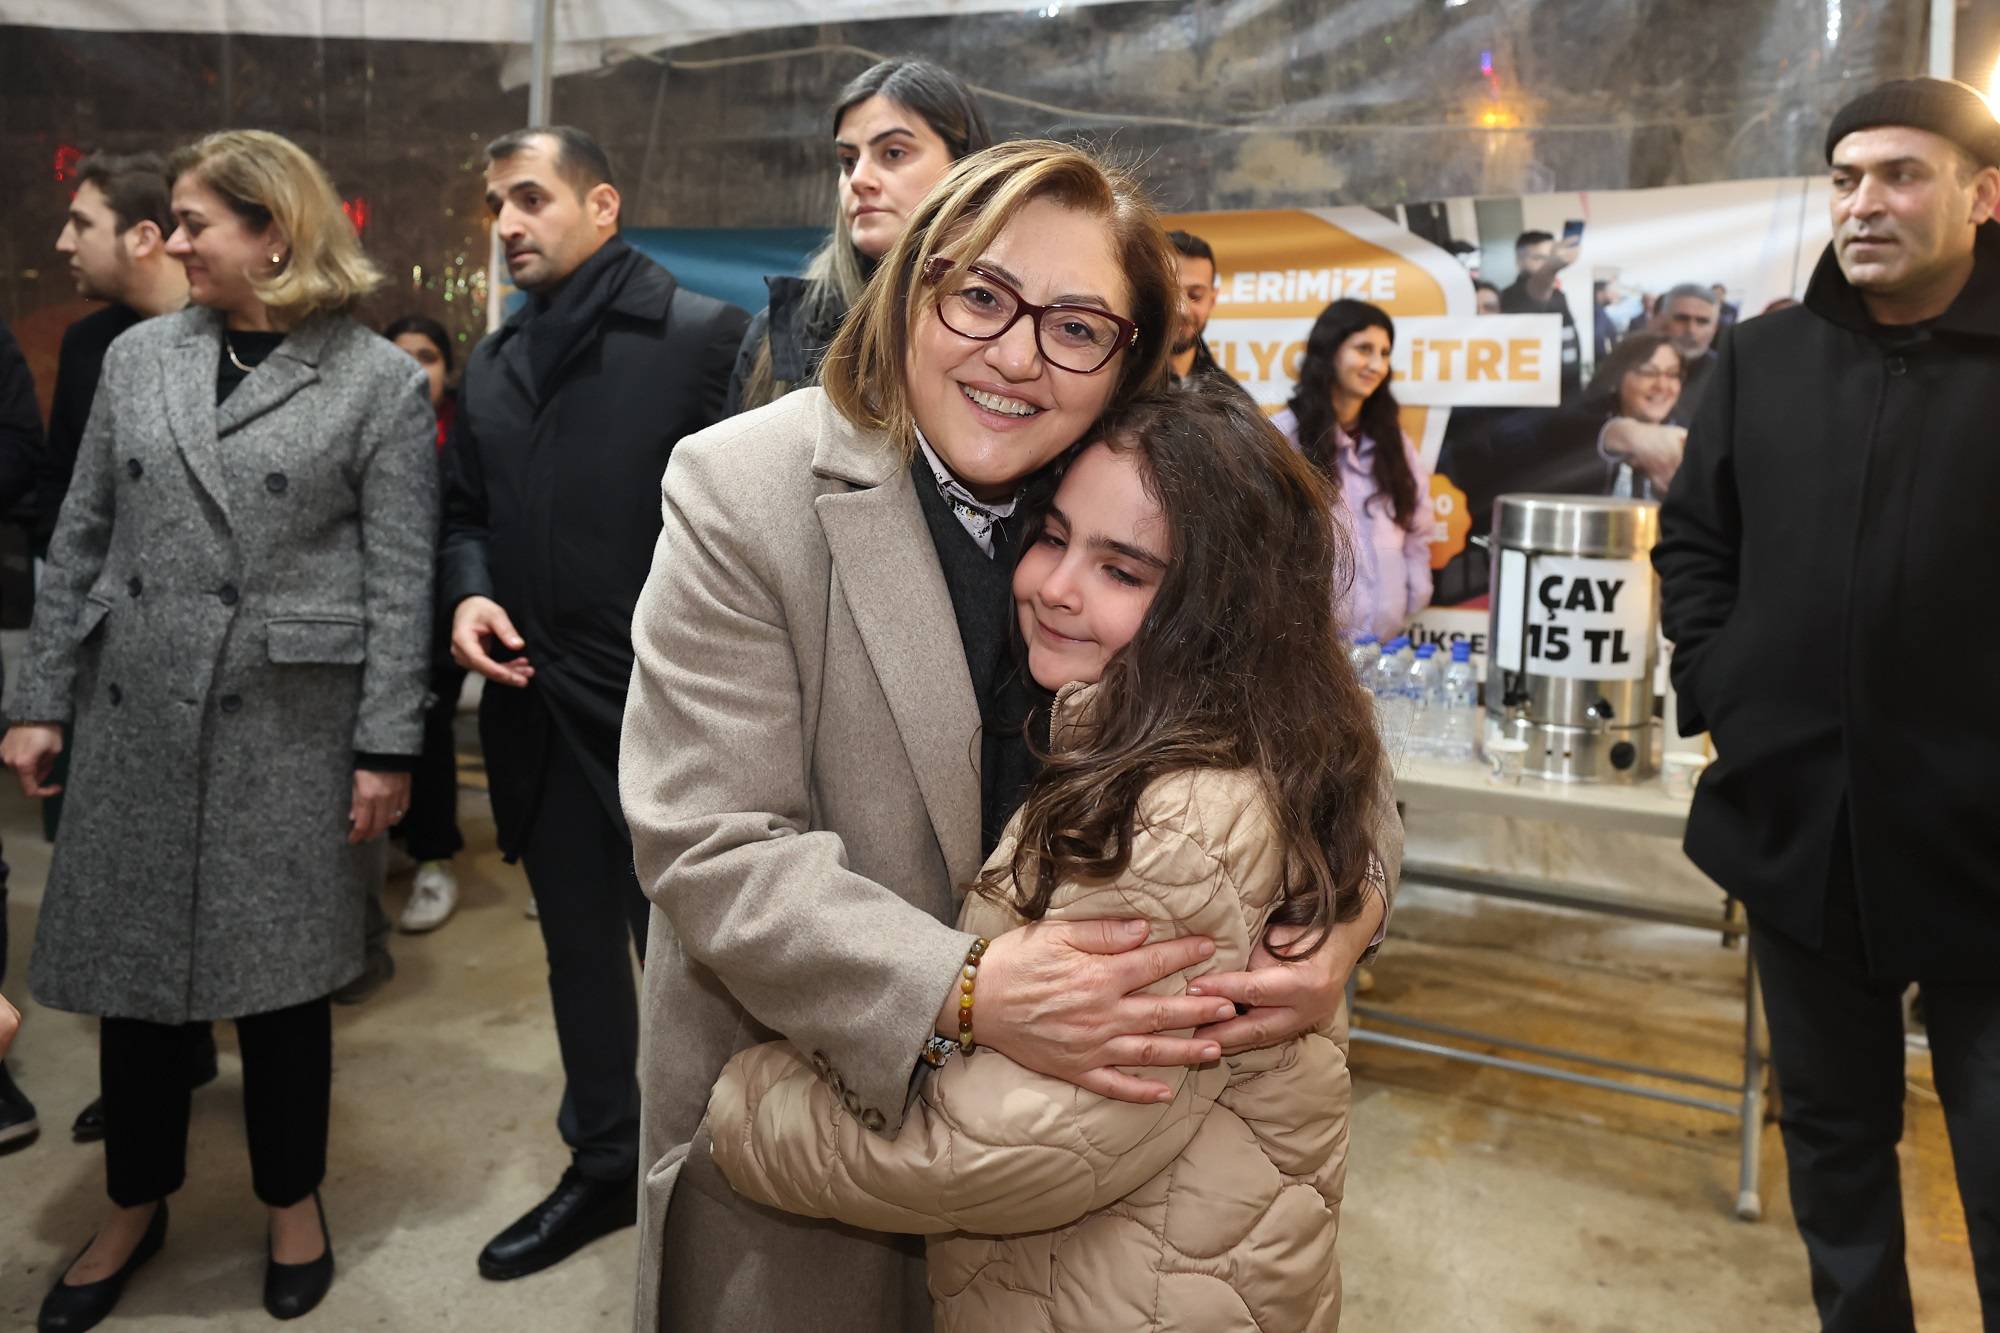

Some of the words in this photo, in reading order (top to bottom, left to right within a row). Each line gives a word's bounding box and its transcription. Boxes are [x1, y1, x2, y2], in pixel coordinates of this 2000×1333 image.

[1538, 575, 1624, 621] ÇAY
[1527, 624, 1571, 662] 15
[1583, 628, 1630, 664] TL
